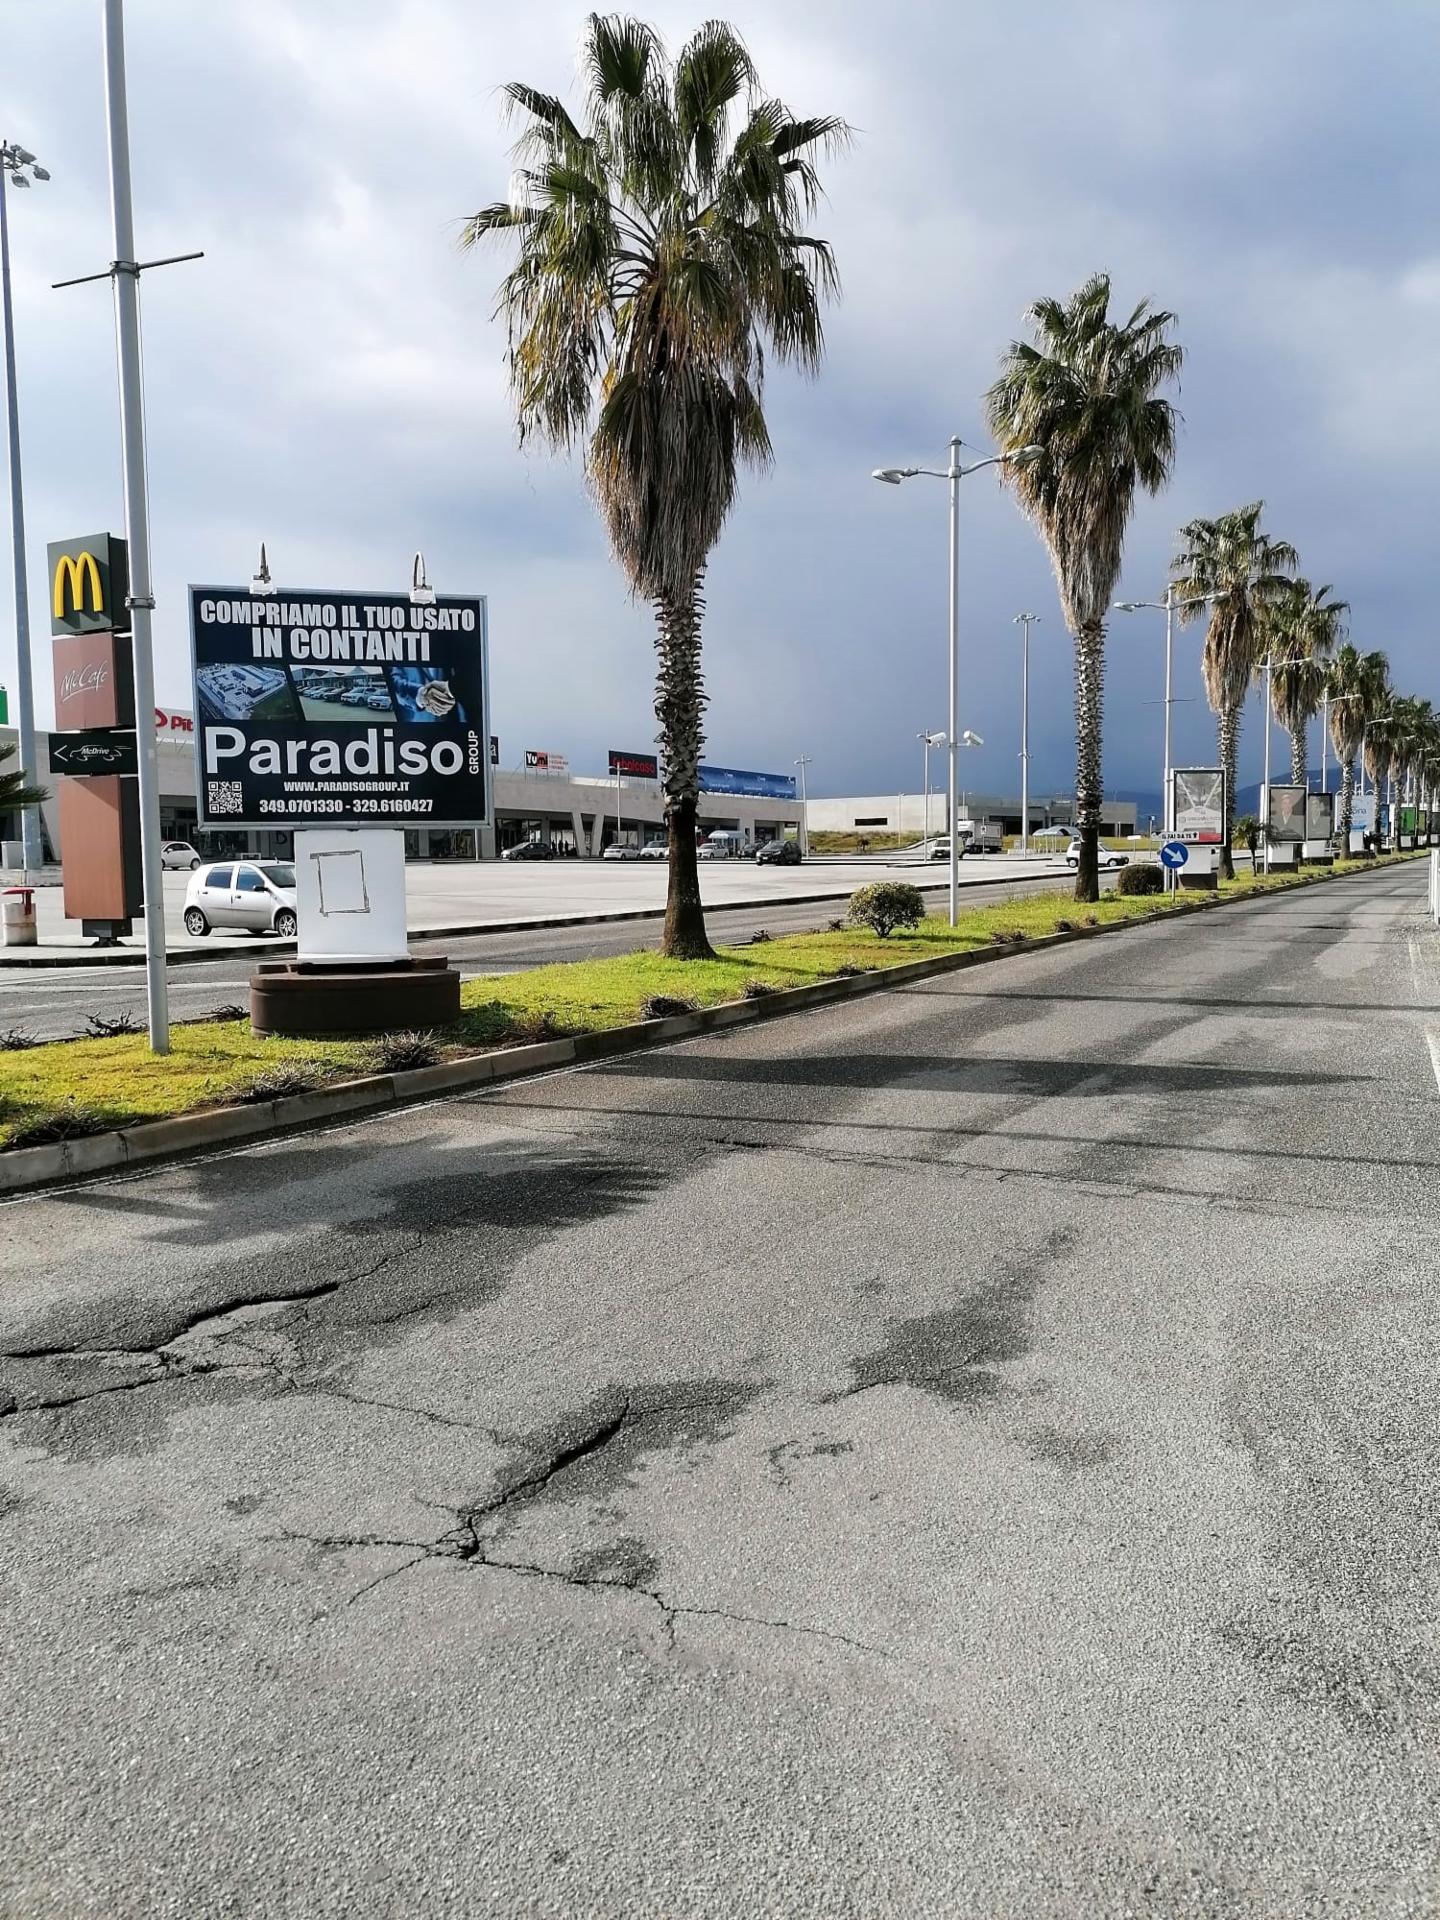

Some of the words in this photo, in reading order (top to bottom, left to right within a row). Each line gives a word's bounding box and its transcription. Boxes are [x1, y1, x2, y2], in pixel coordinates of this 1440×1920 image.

[200, 600, 337, 628] COMPRIAMO
[341, 605, 360, 628] IL
[364, 606, 405, 630] TUO
[410, 607, 475, 632] USATO
[251, 627, 283, 658] IN
[290, 628, 430, 661] CONTANTI
[81, 747, 110, 756] McDrive
[204, 726, 464, 775] Paradiso
[469, 730, 479, 775] GROUP
[283, 781, 410, 792] WWW.PARADISOGROUP.IT
[259, 799, 343, 813] 349.0701330
[353, 799, 433, 813] 329.6160427
